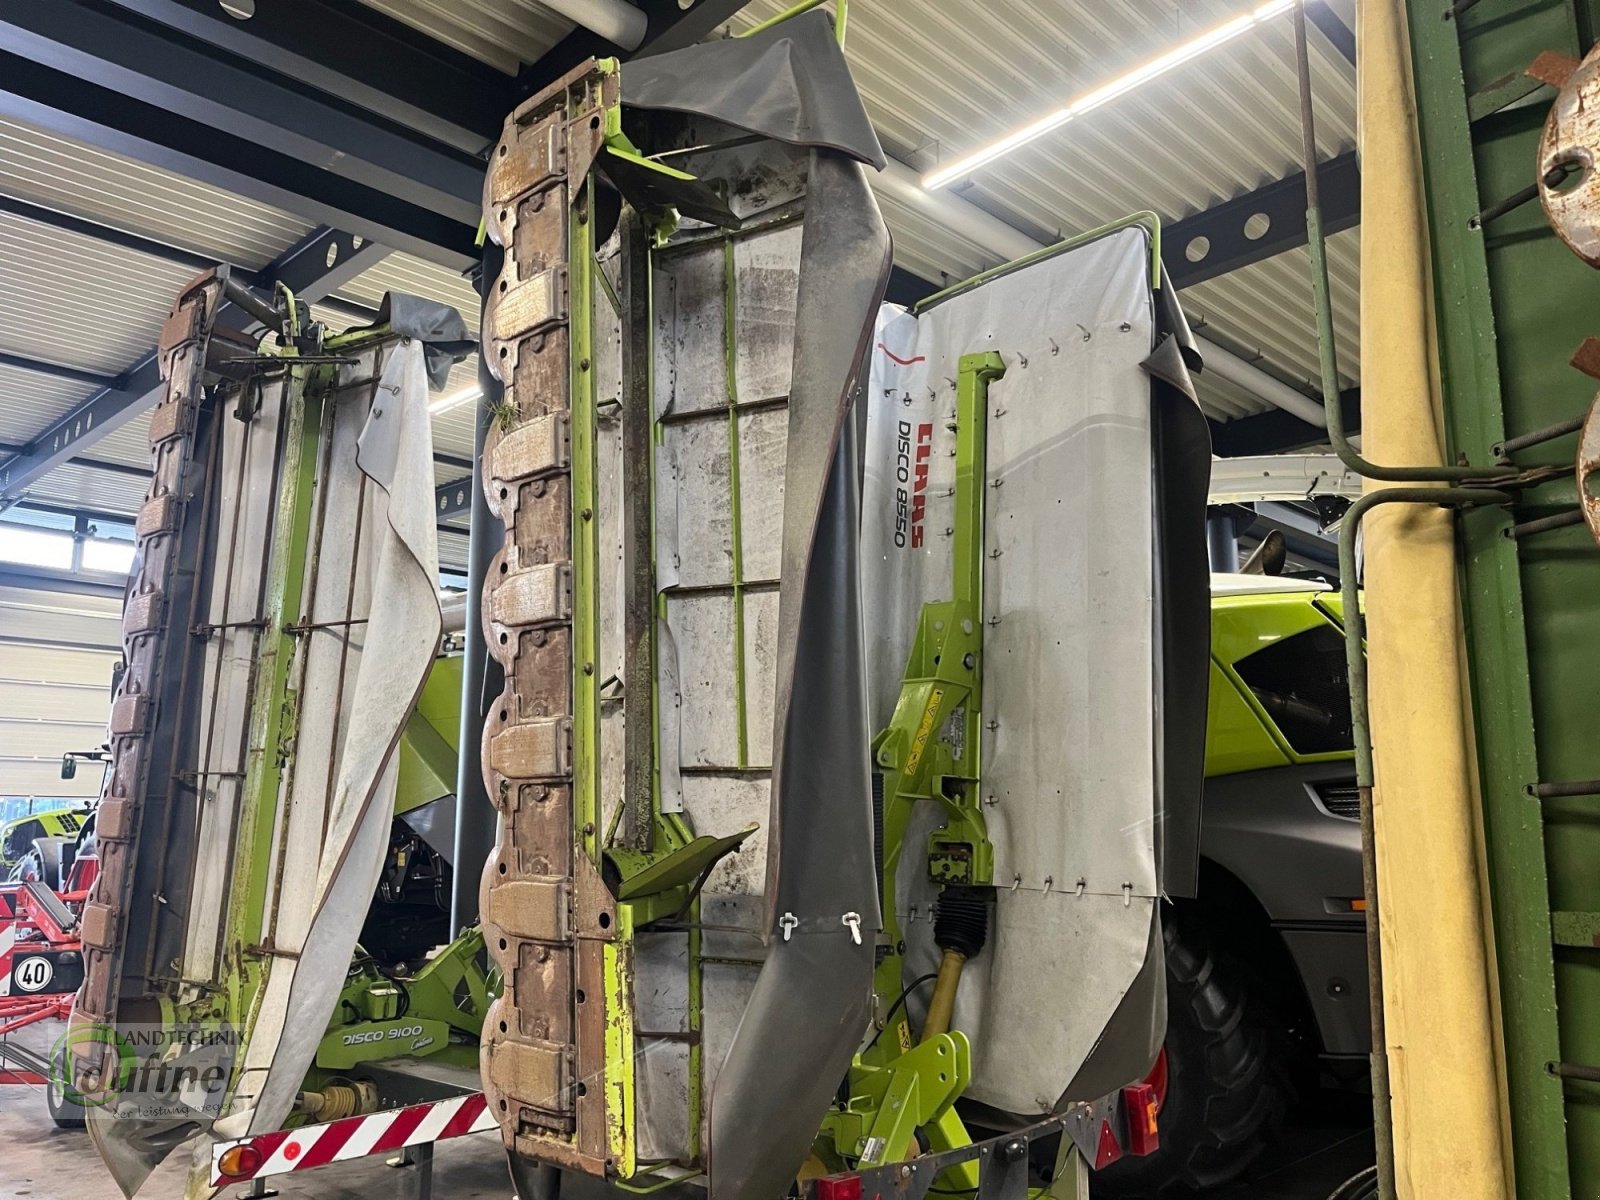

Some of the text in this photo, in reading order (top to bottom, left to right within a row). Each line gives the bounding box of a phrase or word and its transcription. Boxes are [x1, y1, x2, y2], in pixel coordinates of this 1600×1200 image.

[895, 421, 911, 548] DISCO 8550
[912, 423, 933, 548] CLAAS
[22, 963, 45, 985] 40
[343, 1025, 423, 1045] DISCO 9100
